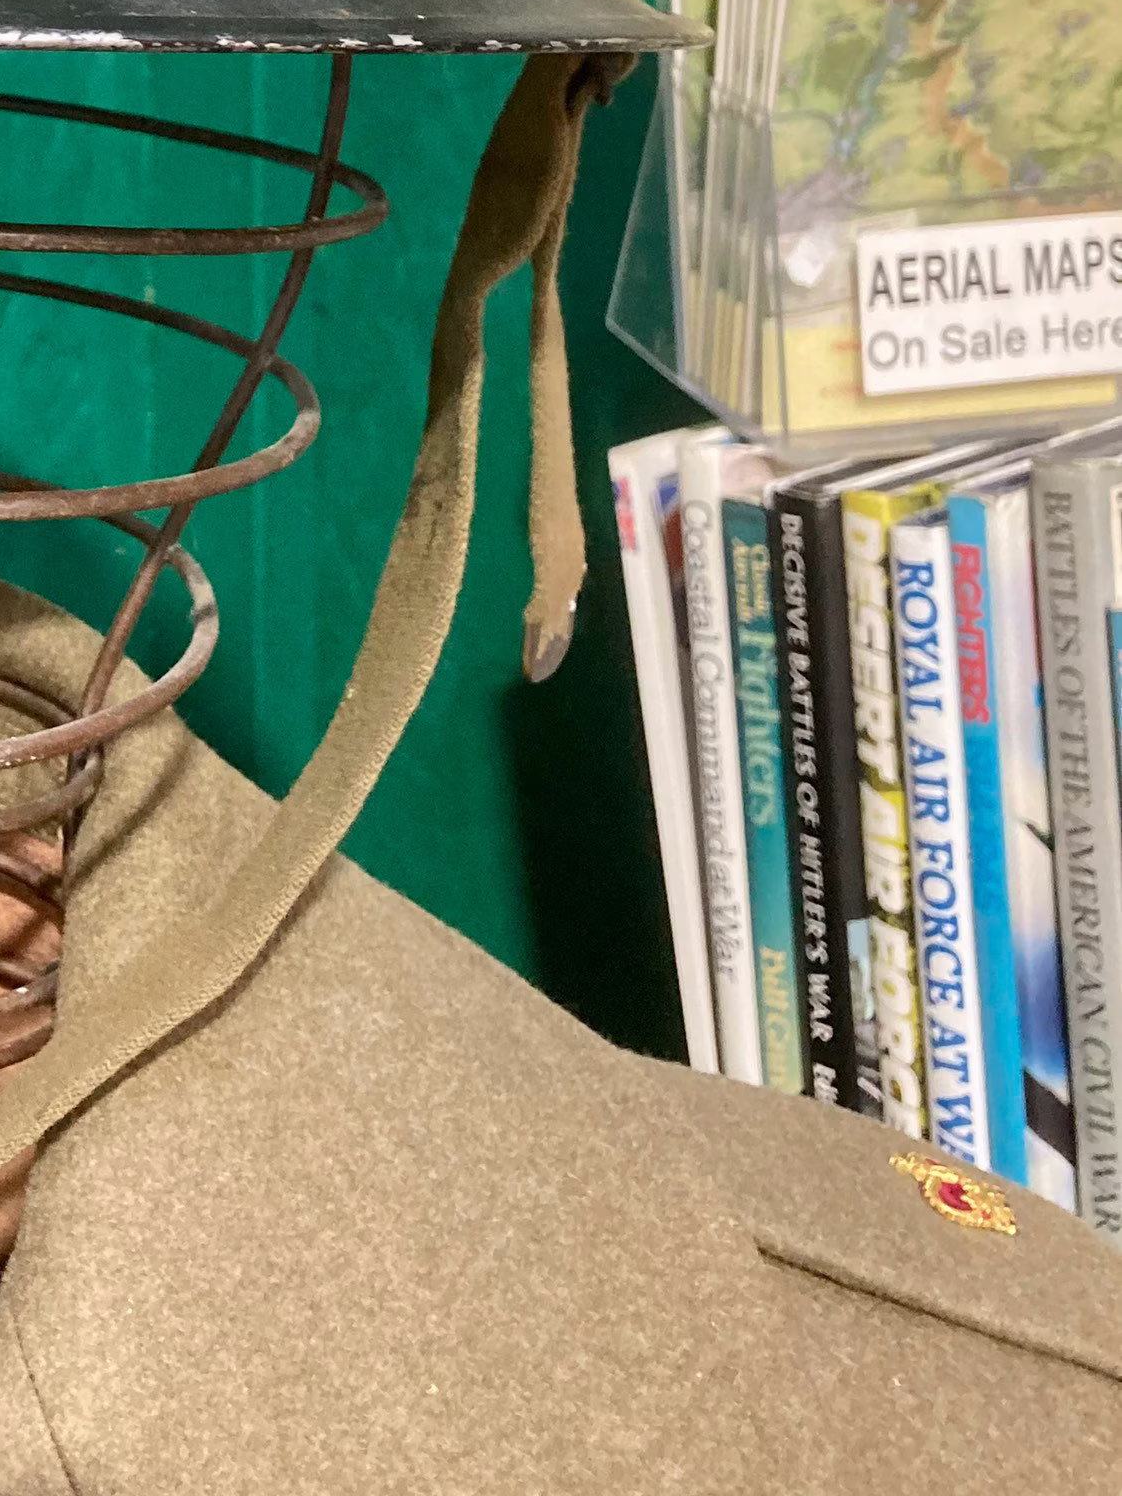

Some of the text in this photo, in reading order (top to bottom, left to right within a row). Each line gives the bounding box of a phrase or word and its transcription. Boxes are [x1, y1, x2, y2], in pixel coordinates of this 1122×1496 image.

[867, 329, 926, 370] On
[940, 316, 1027, 364] Sale
[868, 245, 1011, 311] AERIAL
[682, 500, 721, 645] Coastal
[897, 561, 944, 722] ROYAL
[952, 543, 990, 726] FIGHTERS
[691, 652, 736, 861] Command
[738, 628, 782, 826] Fighters
[781, 512, 834, 1043] DECISIVE BATTLES OF HITLER'S WAR
[909, 737, 950, 824] AIR
[842, 511, 922, 1140] DESERT AIR FORCE
[1044, 490, 1122, 1236] BATTLES OF THE AMERICAN CIVIL WAR
[710, 908, 743, 984] War
[916, 840, 965, 1009] FORCE
[930, 1021, 970, 1085] AT
